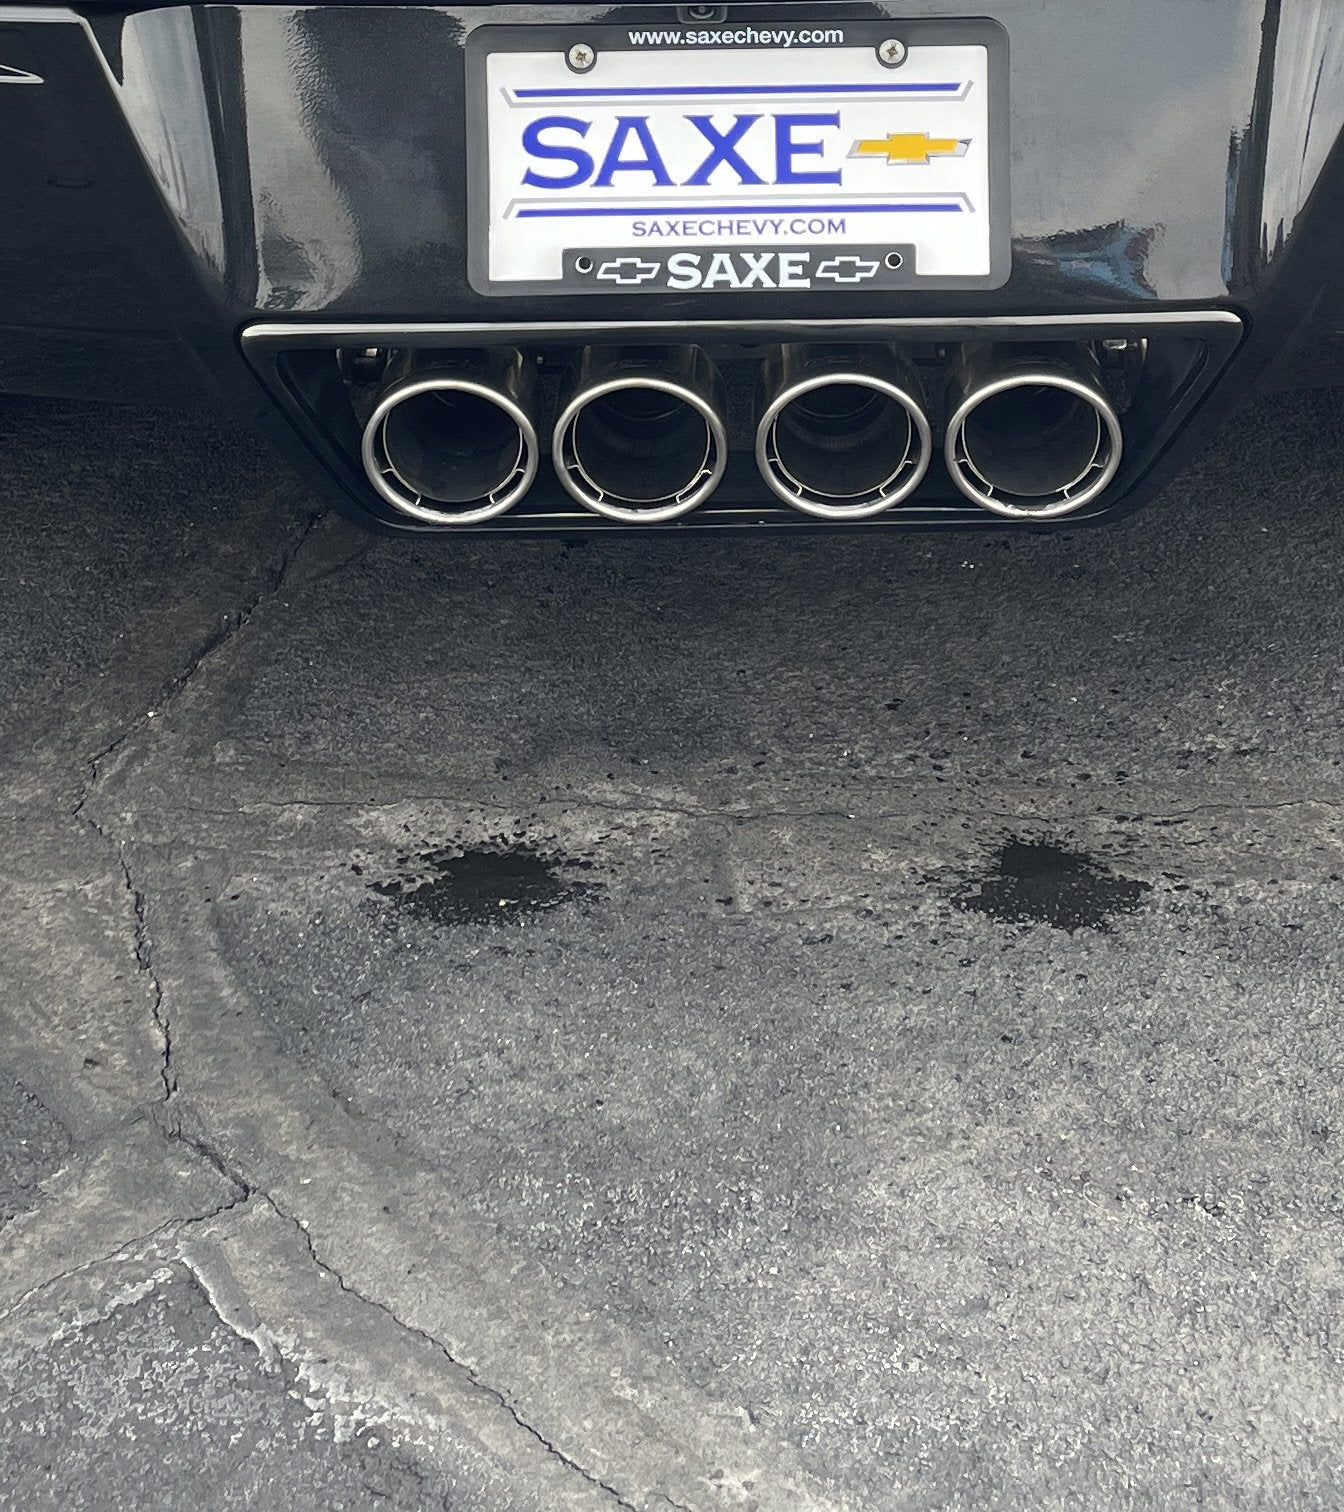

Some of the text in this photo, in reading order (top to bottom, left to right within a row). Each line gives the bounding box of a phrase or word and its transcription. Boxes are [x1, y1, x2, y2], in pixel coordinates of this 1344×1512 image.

[628, 26, 845, 48] www.saxechevy.com
[520, 110, 843, 189] SAXE
[631, 218, 847, 237] SAXECHEVY.COM
[666, 251, 812, 289] SAXE
